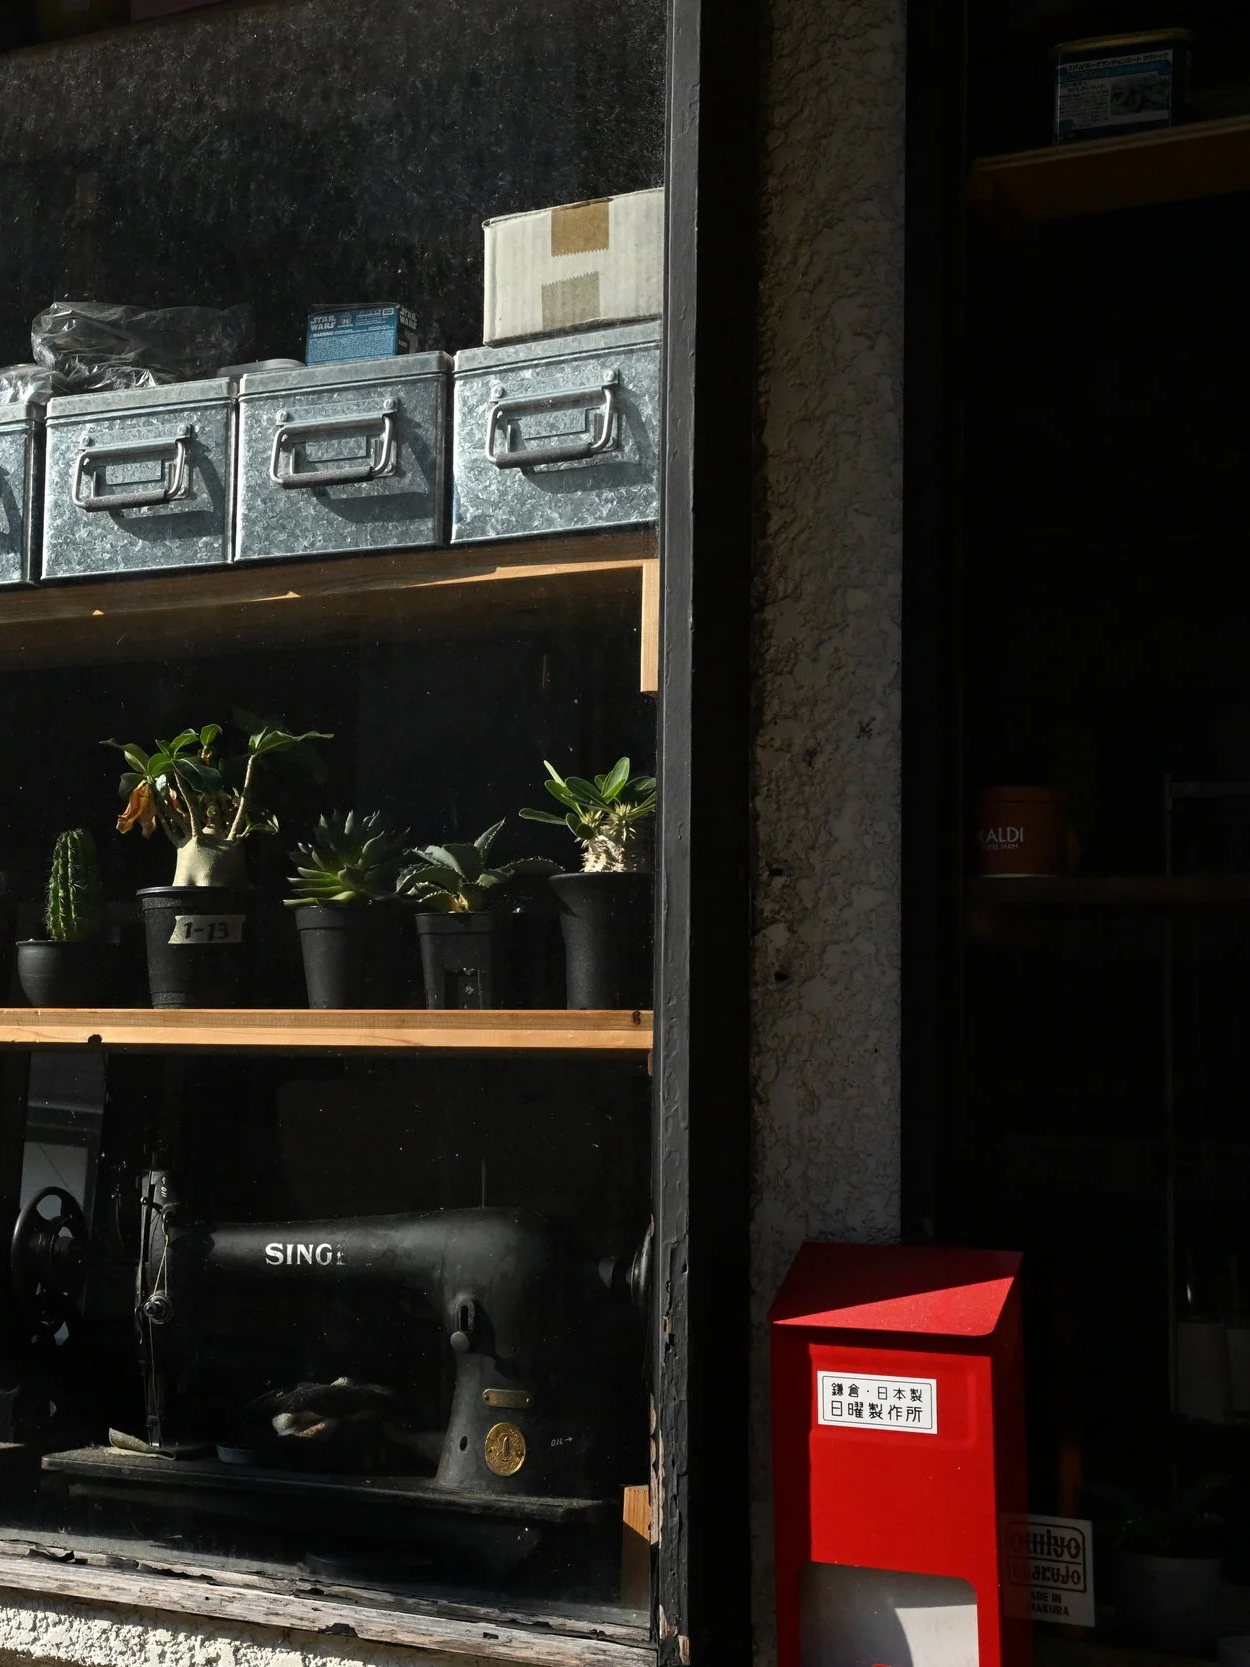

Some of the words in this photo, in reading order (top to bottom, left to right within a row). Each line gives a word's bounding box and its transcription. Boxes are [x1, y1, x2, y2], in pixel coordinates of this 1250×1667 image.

[310, 315, 336, 324] STAR
[310, 322, 336, 331] WARS
[831, 1401, 923, 1423] 日曜製作所
[550, 1438, 564, 1447] OIL
[1031, 1590, 1049, 1602] ADE
[1052, 1593, 1062, 1604] IN
